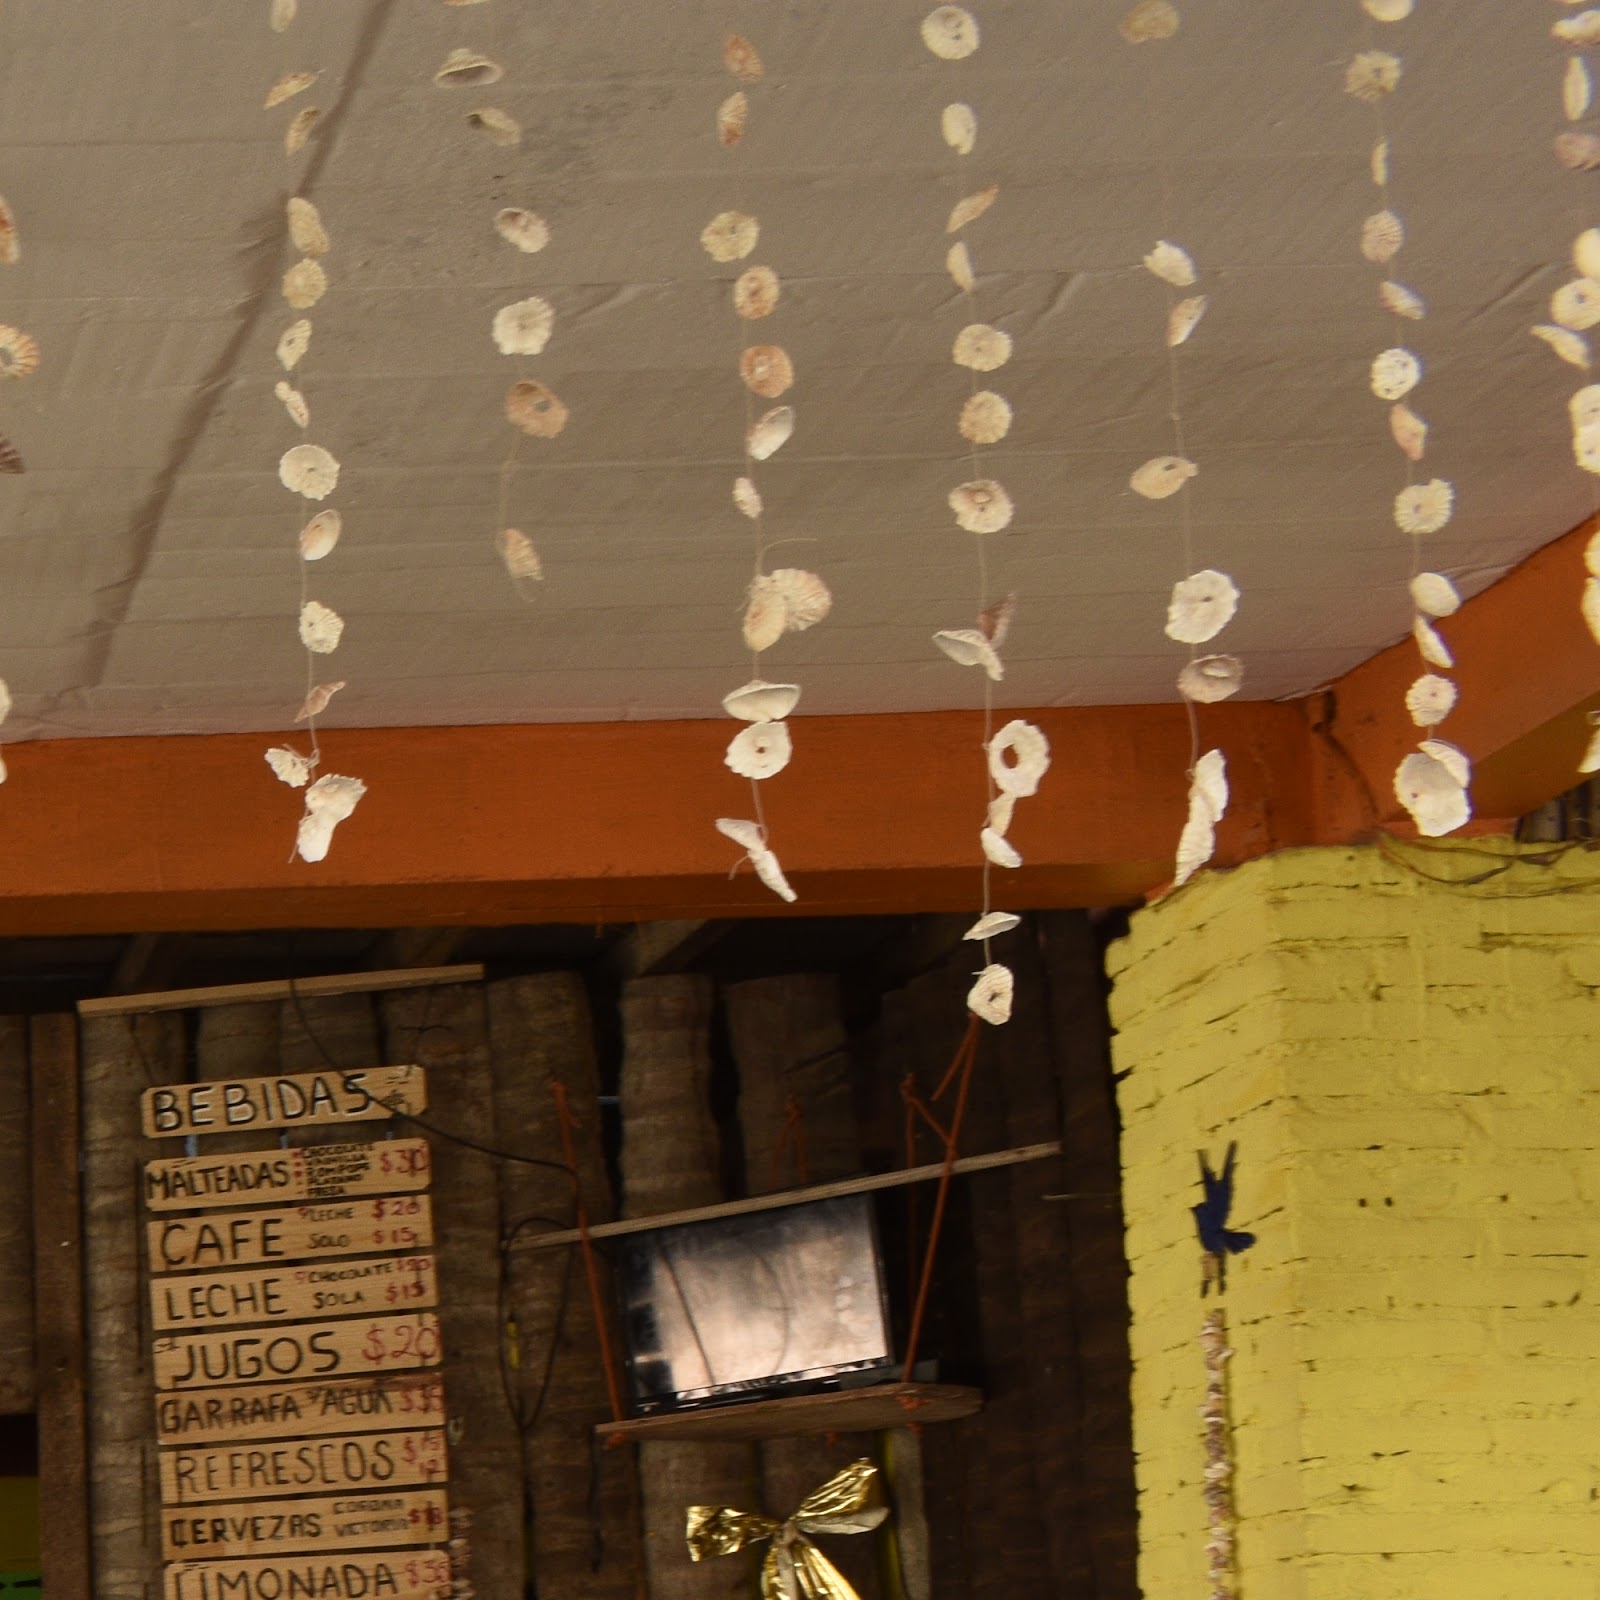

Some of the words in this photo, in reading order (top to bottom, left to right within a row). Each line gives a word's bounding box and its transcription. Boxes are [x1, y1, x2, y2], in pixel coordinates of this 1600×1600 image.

[152, 1074, 372, 1133] BEBIDAS
[147, 1160, 290, 1200] MALTEADAS
[160, 1218, 284, 1266] CAFE
[307, 1233, 350, 1249] SOLO
[163, 1278, 286, 1321] LECHE
[313, 1290, 365, 1310] SOLA
[172, 1331, 340, 1383] JUGOS
[159, 1393, 302, 1434] GARRAFA
[175, 1440, 394, 1493] REFRESCOS
[170, 1513, 321, 1547] CERVEZAS
